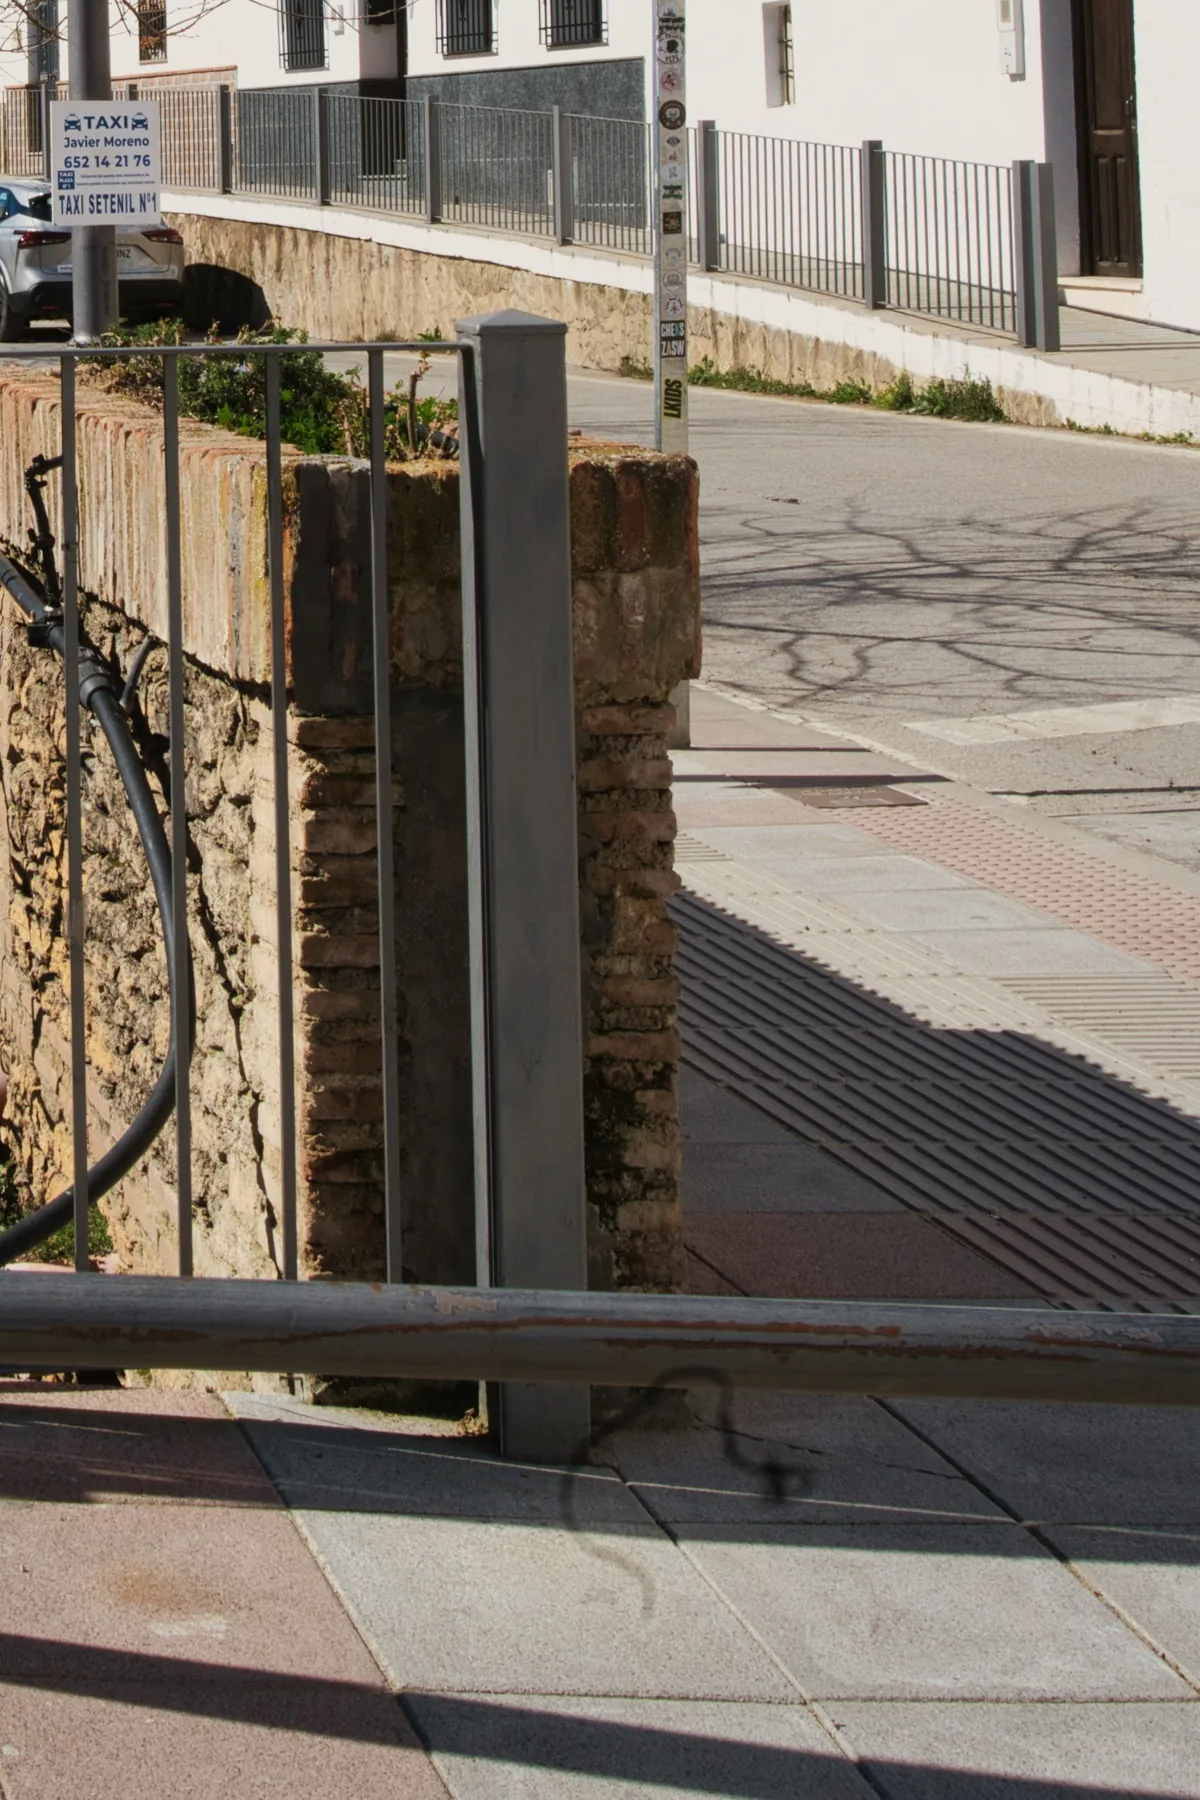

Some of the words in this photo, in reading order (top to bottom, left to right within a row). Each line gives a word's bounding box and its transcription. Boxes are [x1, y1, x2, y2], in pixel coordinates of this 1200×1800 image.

[83, 115, 128, 130] TAXI
[64, 136, 100, 148] Javier
[104, 137, 149, 147] Moreno
[64, 156, 89, 168] 652
[95, 156, 110, 168] 14
[115, 155, 128, 167] 21
[134, 155, 151, 167] 76
[59, 195, 84, 215] TAXI
[89, 193, 135, 214] SETENIL
